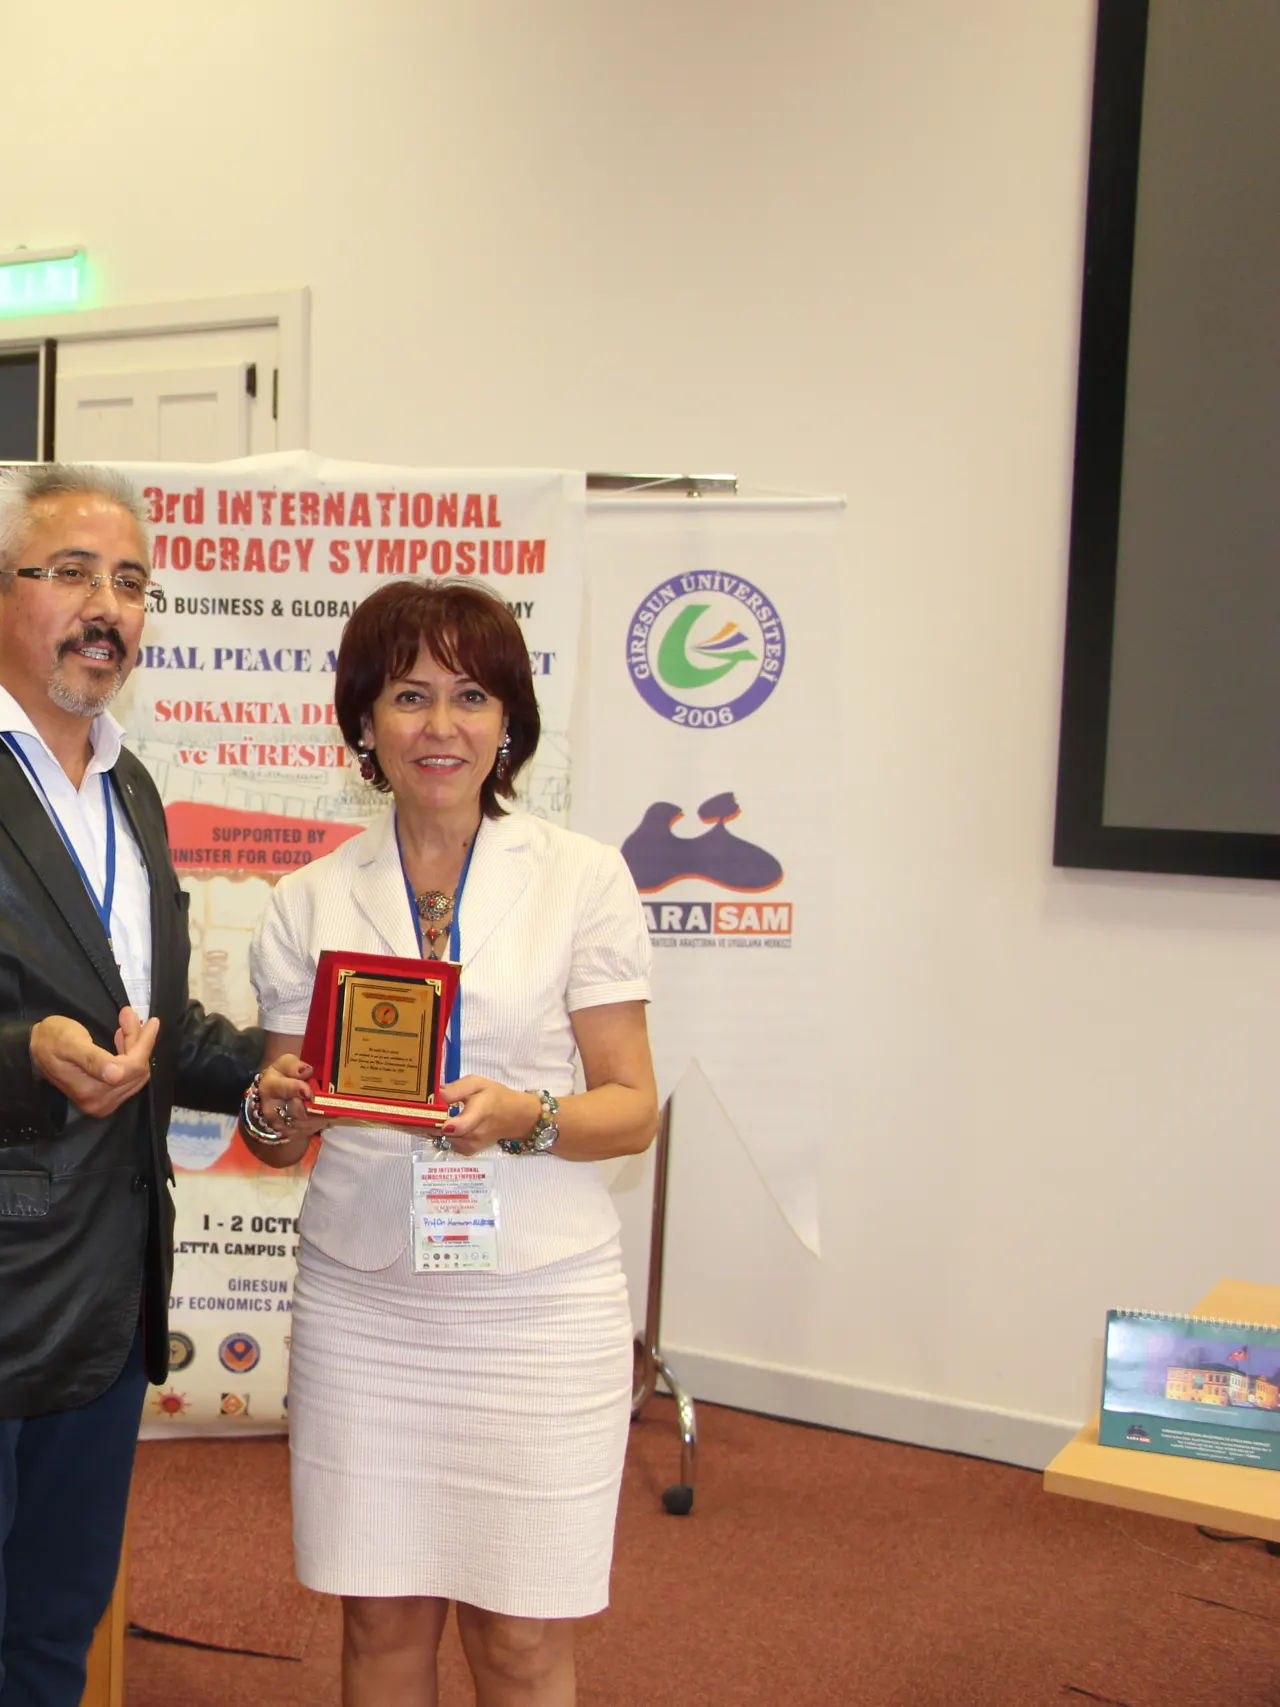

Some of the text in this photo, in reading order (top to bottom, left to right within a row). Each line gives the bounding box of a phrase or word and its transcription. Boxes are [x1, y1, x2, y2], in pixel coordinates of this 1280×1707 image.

[143, 487, 501, 528] 3rd INTERNATIONAL
[328, 539, 546, 575] SYMPOSIUM
[175, 598, 264, 616] BUSINESS
[271, 599, 284, 616] &
[627, 571, 783, 682] GİRESUN ÜNİVERSİTESİ
[212, 647, 312, 672] PEACE
[154, 699, 292, 725] SOKAKTA
[672, 705, 734, 727] 2006
[179, 736, 353, 768] ve KÜRESEL
[212, 827, 326, 843] SUPPORTED BY
[170, 849, 312, 865] INISTER FOR GOZO
[717, 905, 790, 931] SAM
[230, 1215, 243, 1232] 2
[224, 1243, 286, 1257] CAMPUS
[228, 1276, 287, 1293] GİRESUN
[189, 1297, 271, 1312] ECONOMICS
